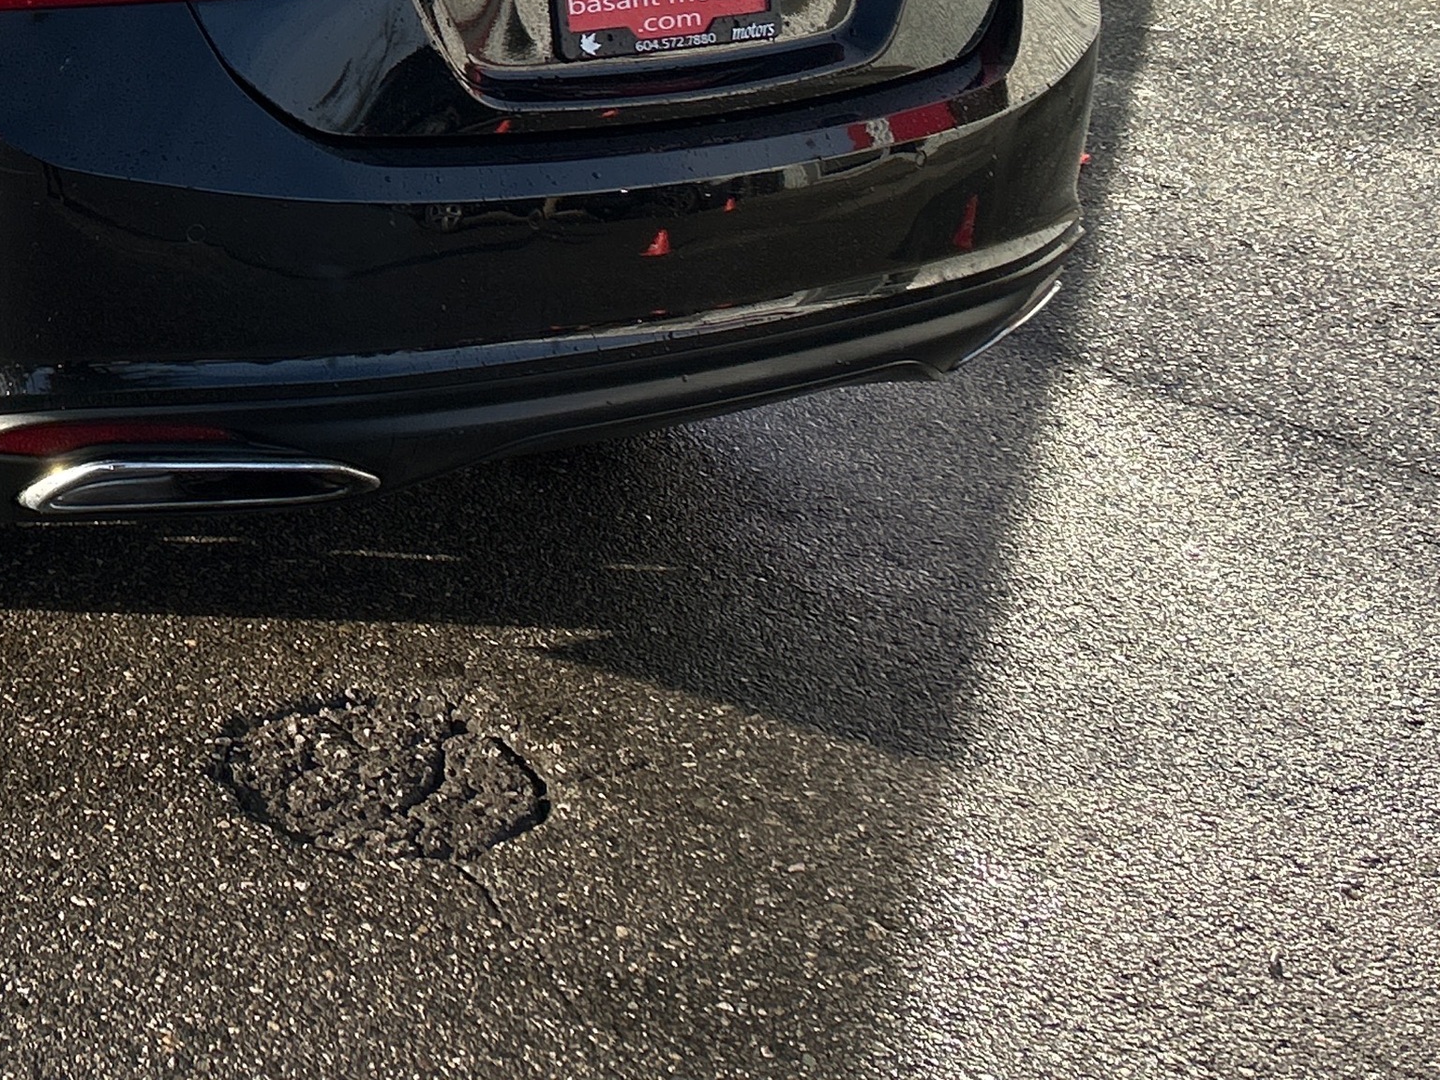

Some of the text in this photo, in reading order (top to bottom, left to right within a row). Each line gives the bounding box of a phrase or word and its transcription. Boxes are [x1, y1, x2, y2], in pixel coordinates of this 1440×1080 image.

[637, 12, 701, 32] .com
[731, 22, 775, 41] motors
[635, 33, 716, 52] 604.572.7880
